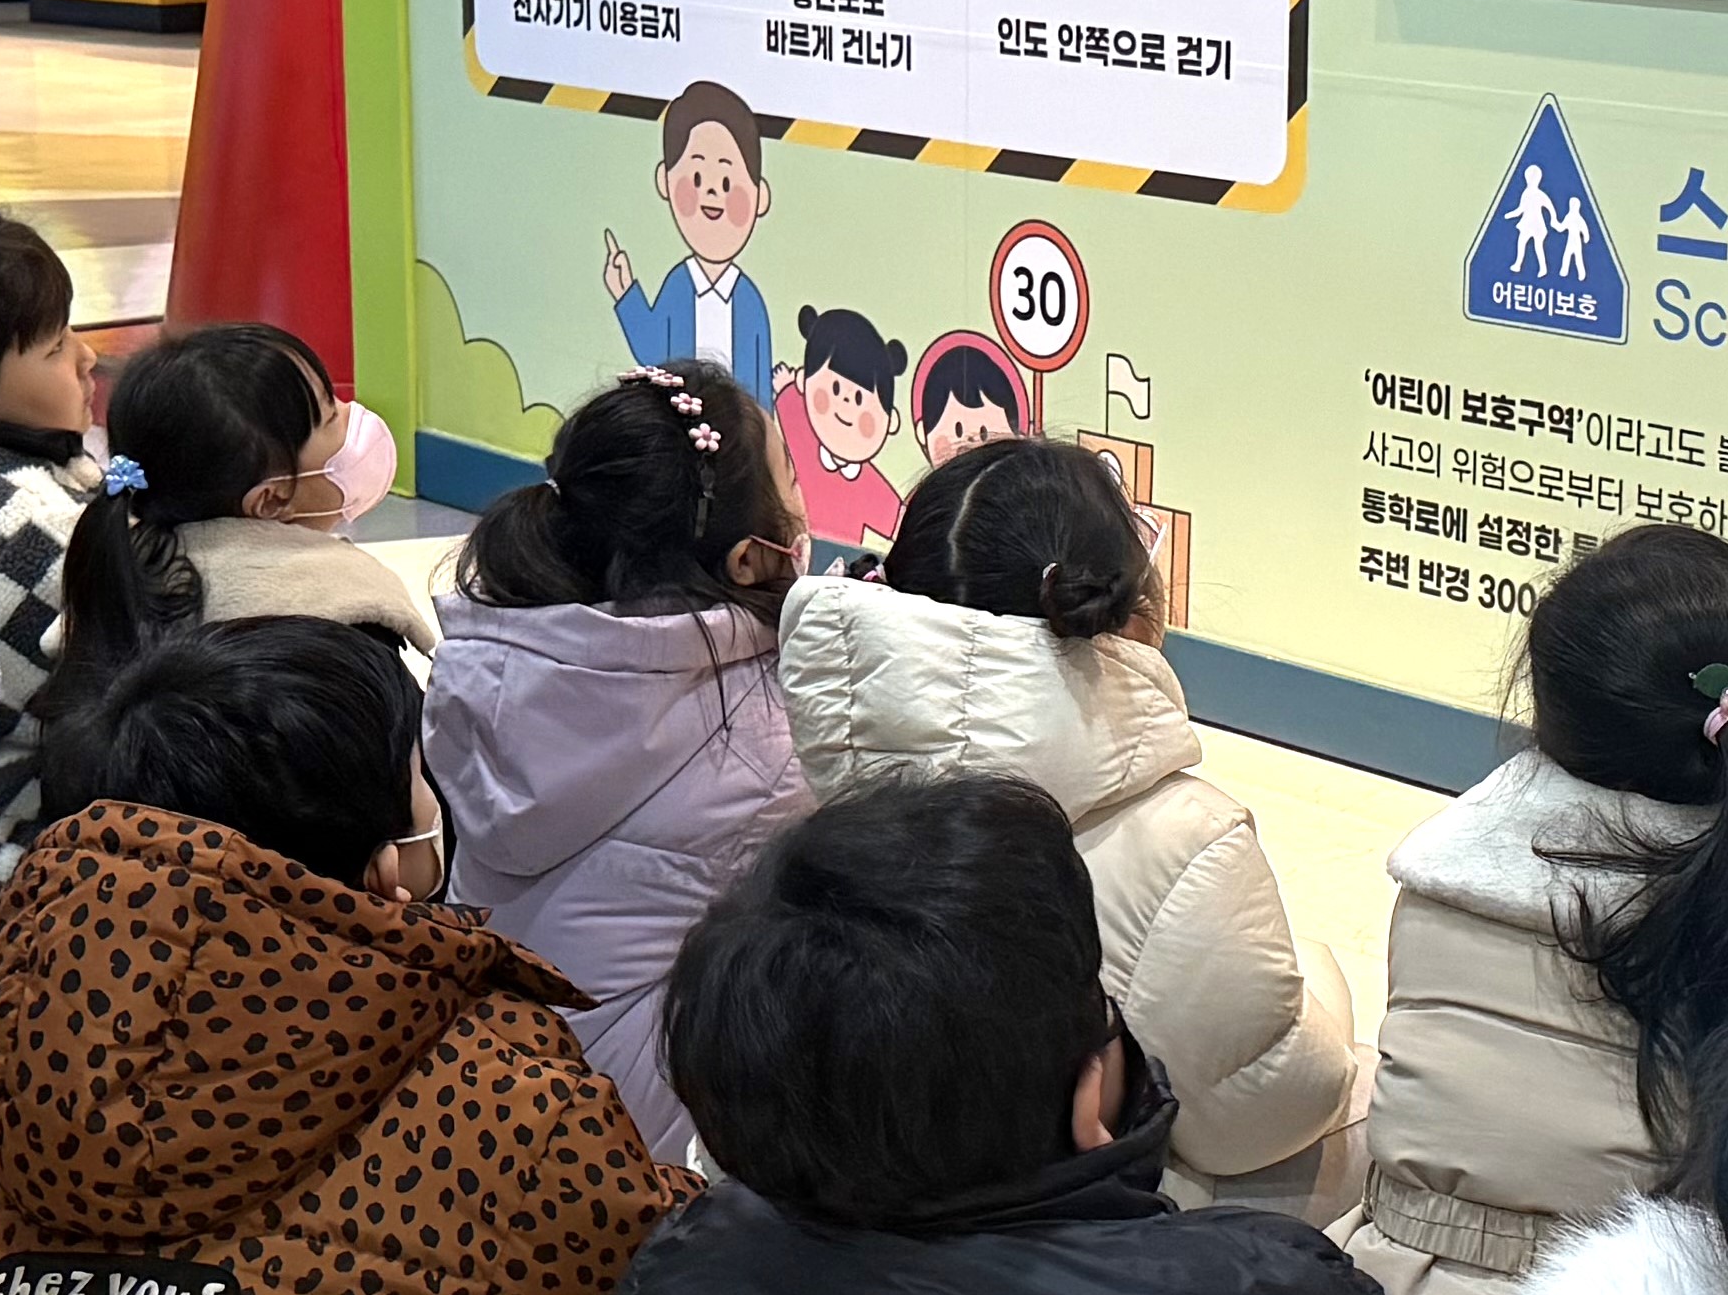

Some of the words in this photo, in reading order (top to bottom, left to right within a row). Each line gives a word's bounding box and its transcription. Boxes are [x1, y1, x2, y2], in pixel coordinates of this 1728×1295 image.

[599, 0, 681, 43] 이용금지
[766, 18, 834, 62] 바르게
[841, 26, 913, 72] 건너기
[996, 17, 1049, 61] 인도
[1057, 22, 1167, 75] 안쪽으로
[1175, 32, 1233, 82] 걷기
[1011, 264, 1068, 328] 30
[1492, 281, 1598, 321] 어린이보호
[1363, 430, 1442, 478] 사고의
[1451, 447, 1623, 516] 위험으로부터
[1361, 487, 1468, 543] 통학로에
[1477, 512, 1561, 564] 설정한
[1359, 545, 1410, 589] 주변
[1418, 558, 1470, 603] 반경
